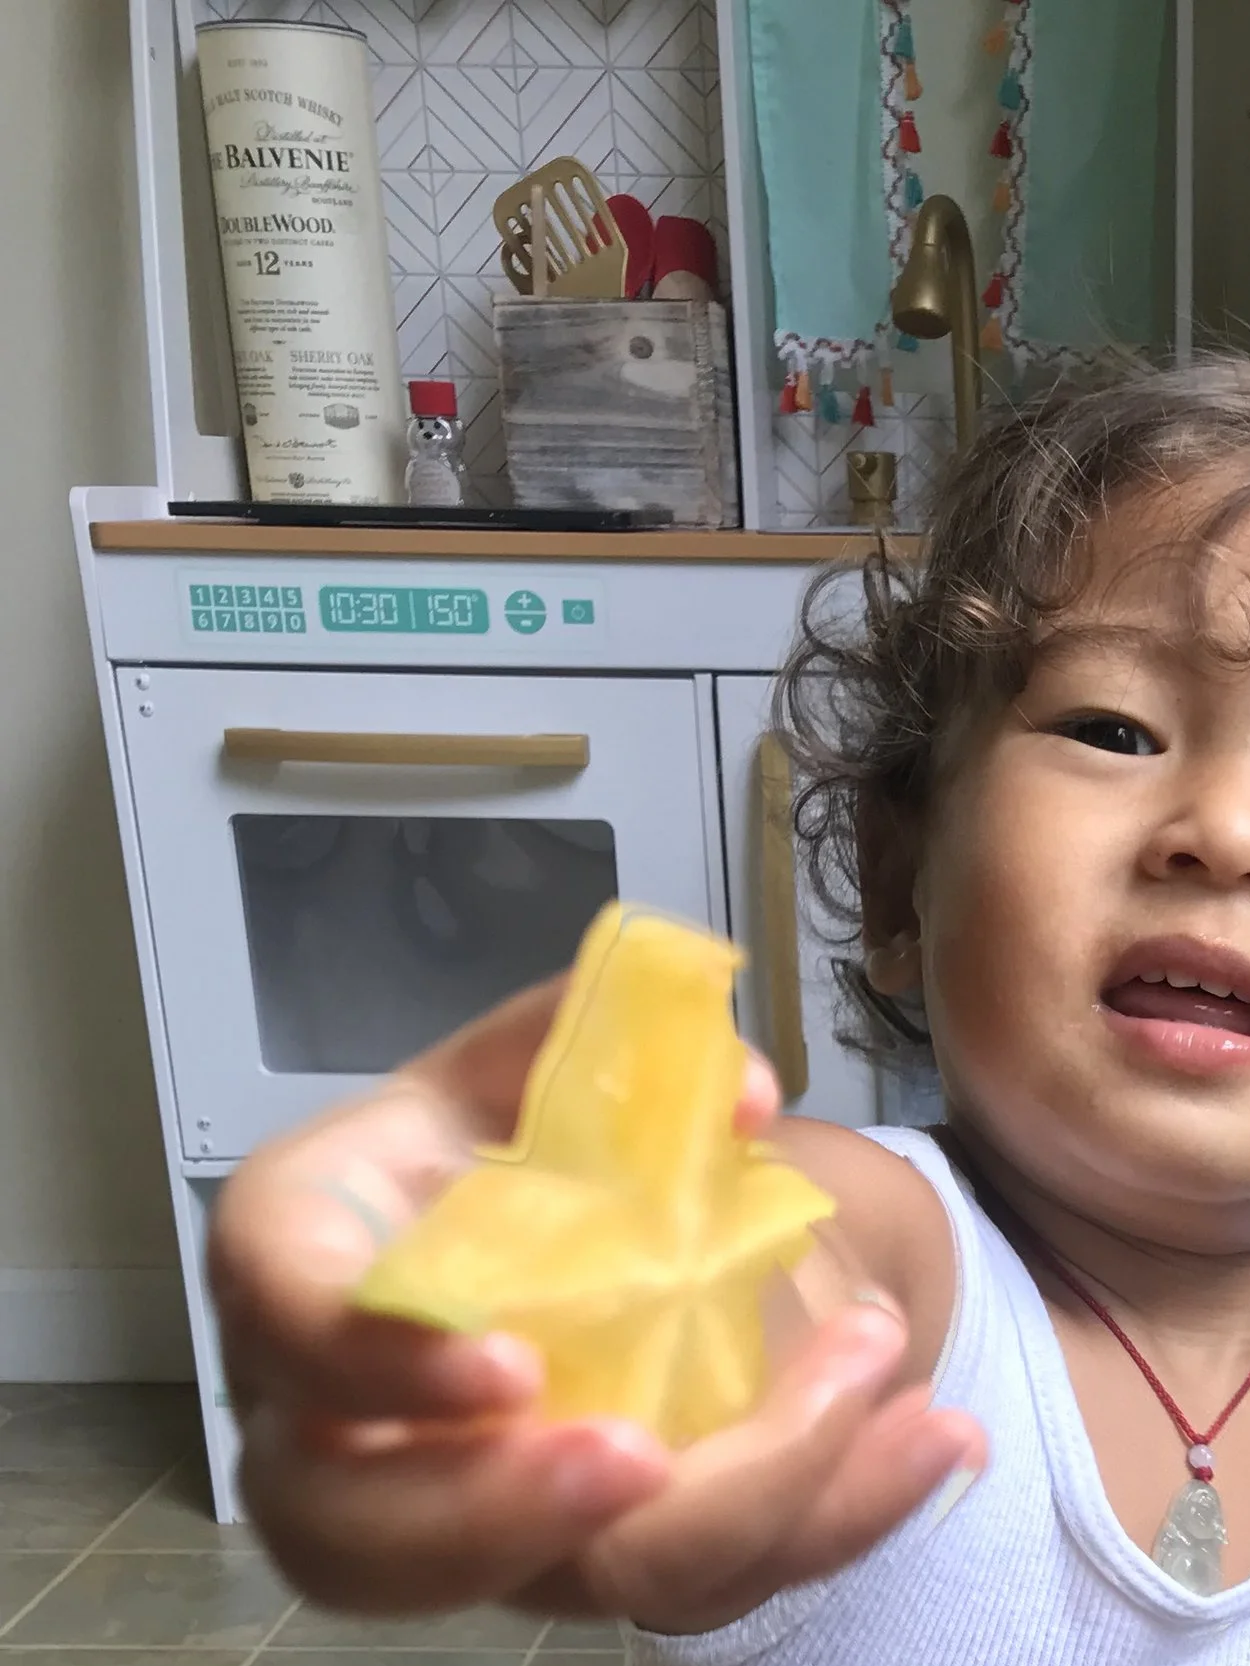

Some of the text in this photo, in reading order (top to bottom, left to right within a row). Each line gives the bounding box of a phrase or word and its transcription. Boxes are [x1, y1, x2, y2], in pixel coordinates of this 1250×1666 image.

[243, 88, 293, 106] SCOTCH
[297, 95, 343, 127] WHISKY
[224, 144, 350, 173] BALVENIE
[253, 250, 281, 276] 12
[283, 259, 314, 268] YEARS
[289, 350, 375, 366] SHERRY OAK
[196, 588, 298, 605] 1 2 3 4 5
[328, 592, 399, 626] 10:30
[198, 612, 302, 630] 6 7 8 9 0
